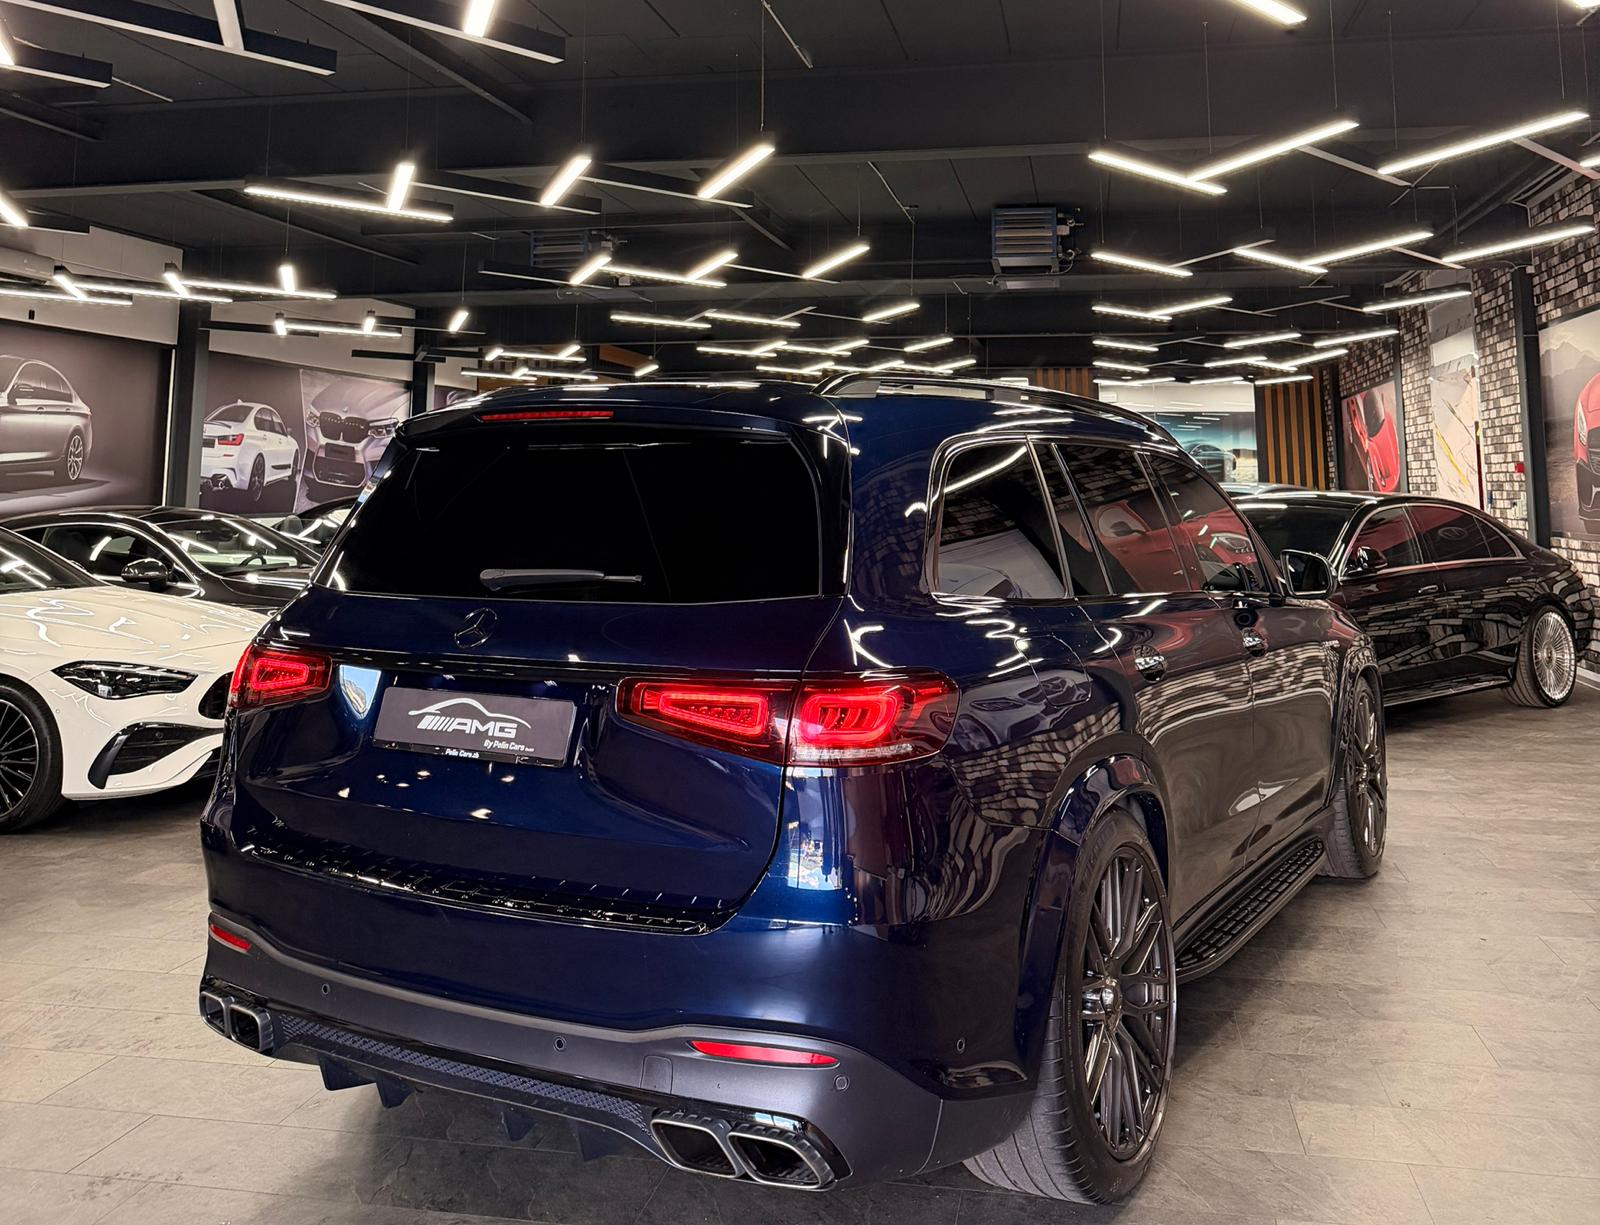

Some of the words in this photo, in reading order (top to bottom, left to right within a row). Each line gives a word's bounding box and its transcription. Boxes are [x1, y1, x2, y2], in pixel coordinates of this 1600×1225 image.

[447, 717, 517, 738] AMG
[483, 739, 493, 749] By
[509, 742, 525, 751] Cars
